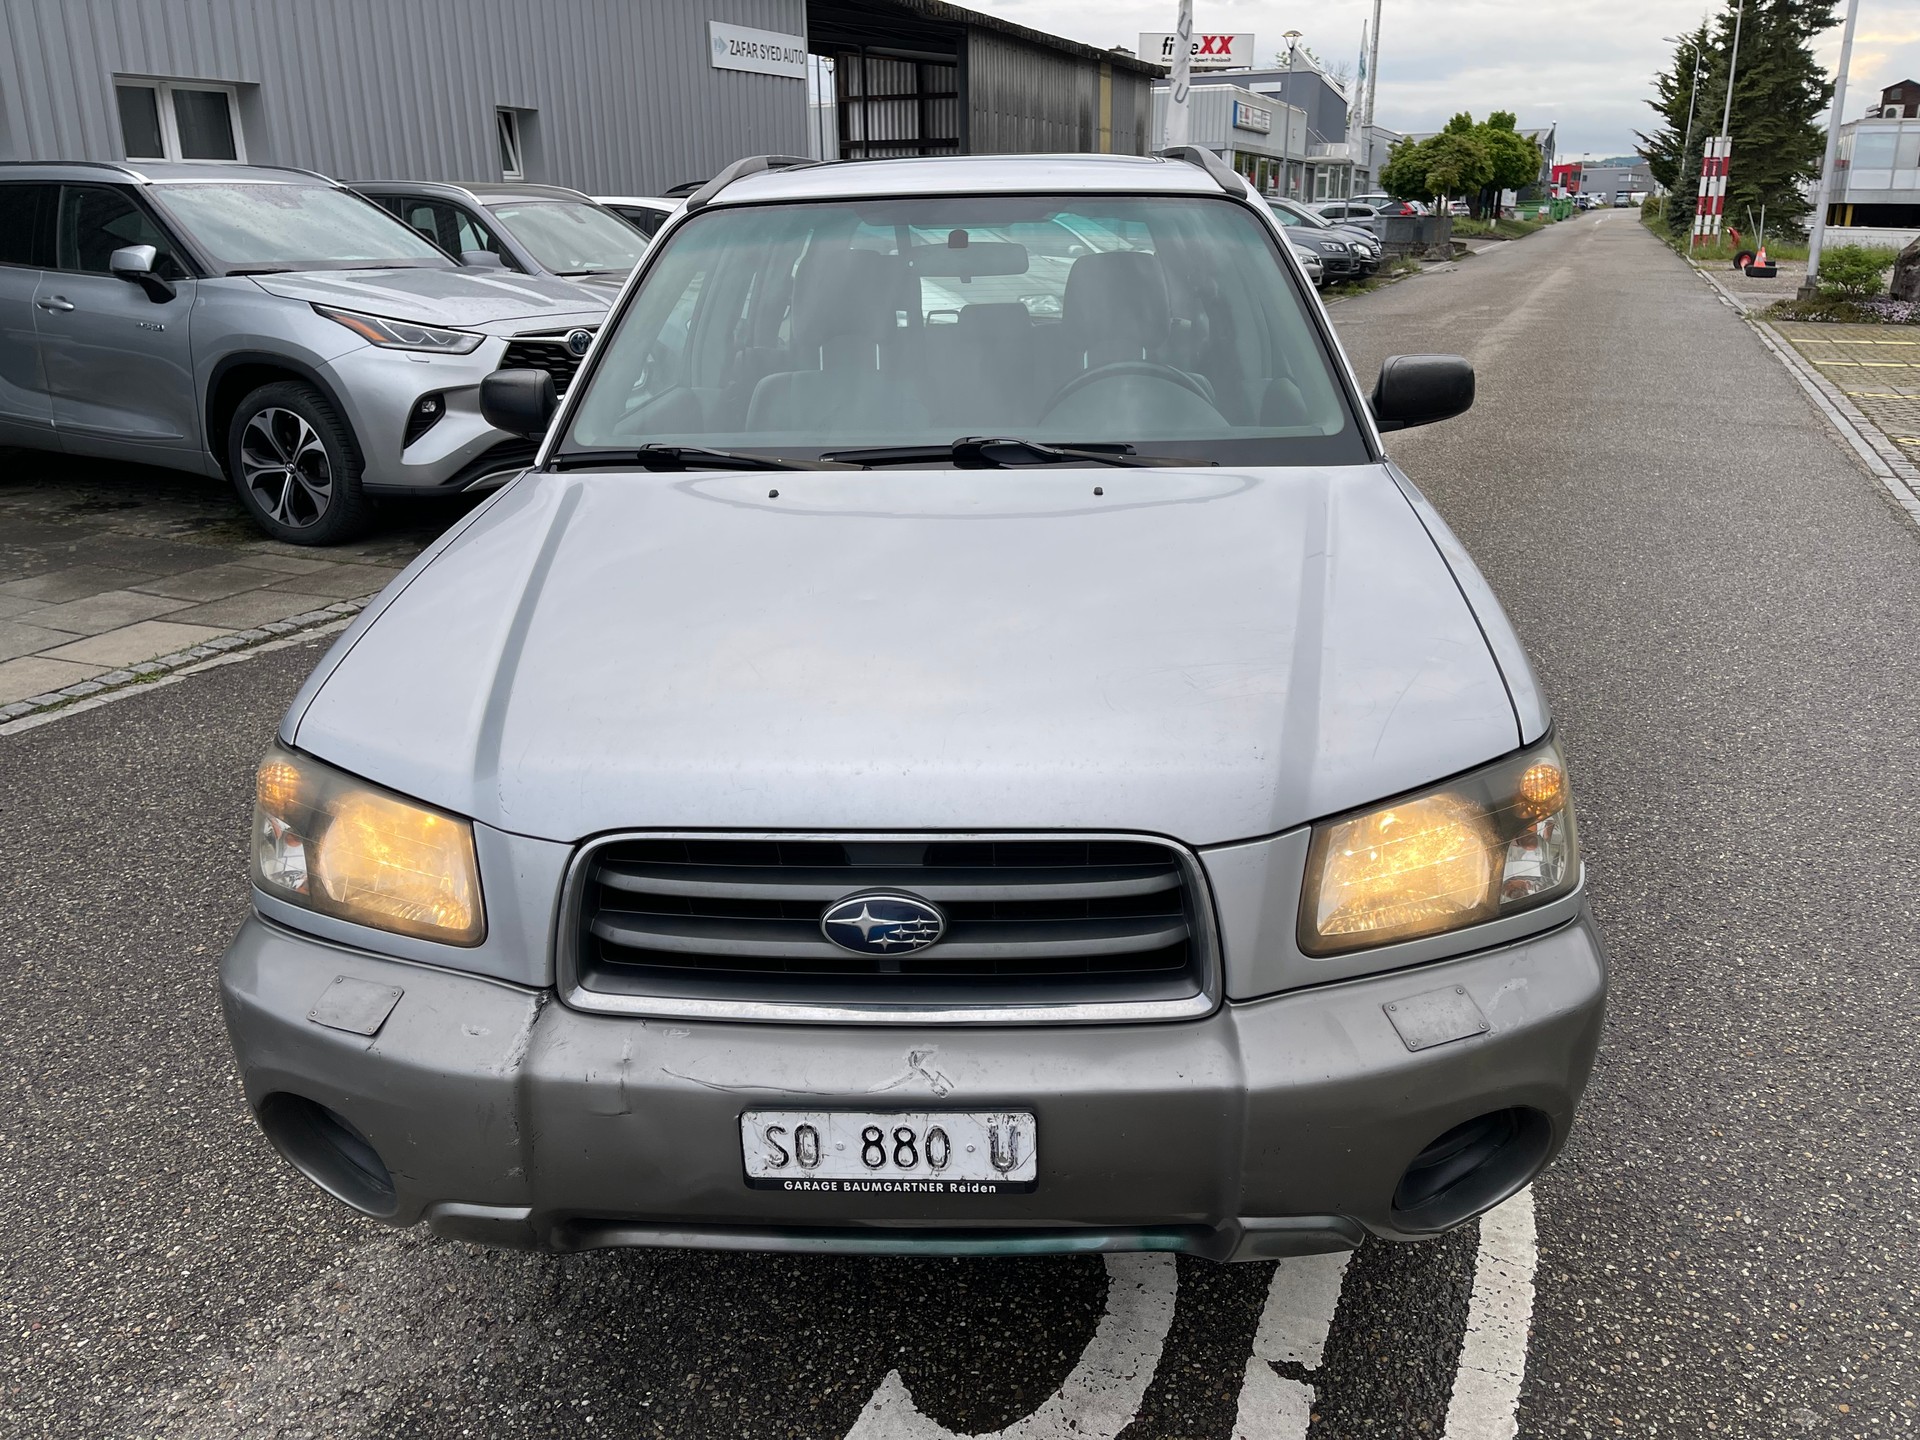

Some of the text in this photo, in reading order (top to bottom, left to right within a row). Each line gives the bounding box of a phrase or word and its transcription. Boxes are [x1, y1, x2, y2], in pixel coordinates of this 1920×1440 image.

[730, 40, 804, 65] ZAFAR SYED AUTO
[1162, 36, 1234, 55] fieXX
[861, 1125, 951, 1169] 880
[988, 1125, 1018, 1172] U
[784, 1181, 996, 1193] GARAGE BAUMGARTNER Reiden
